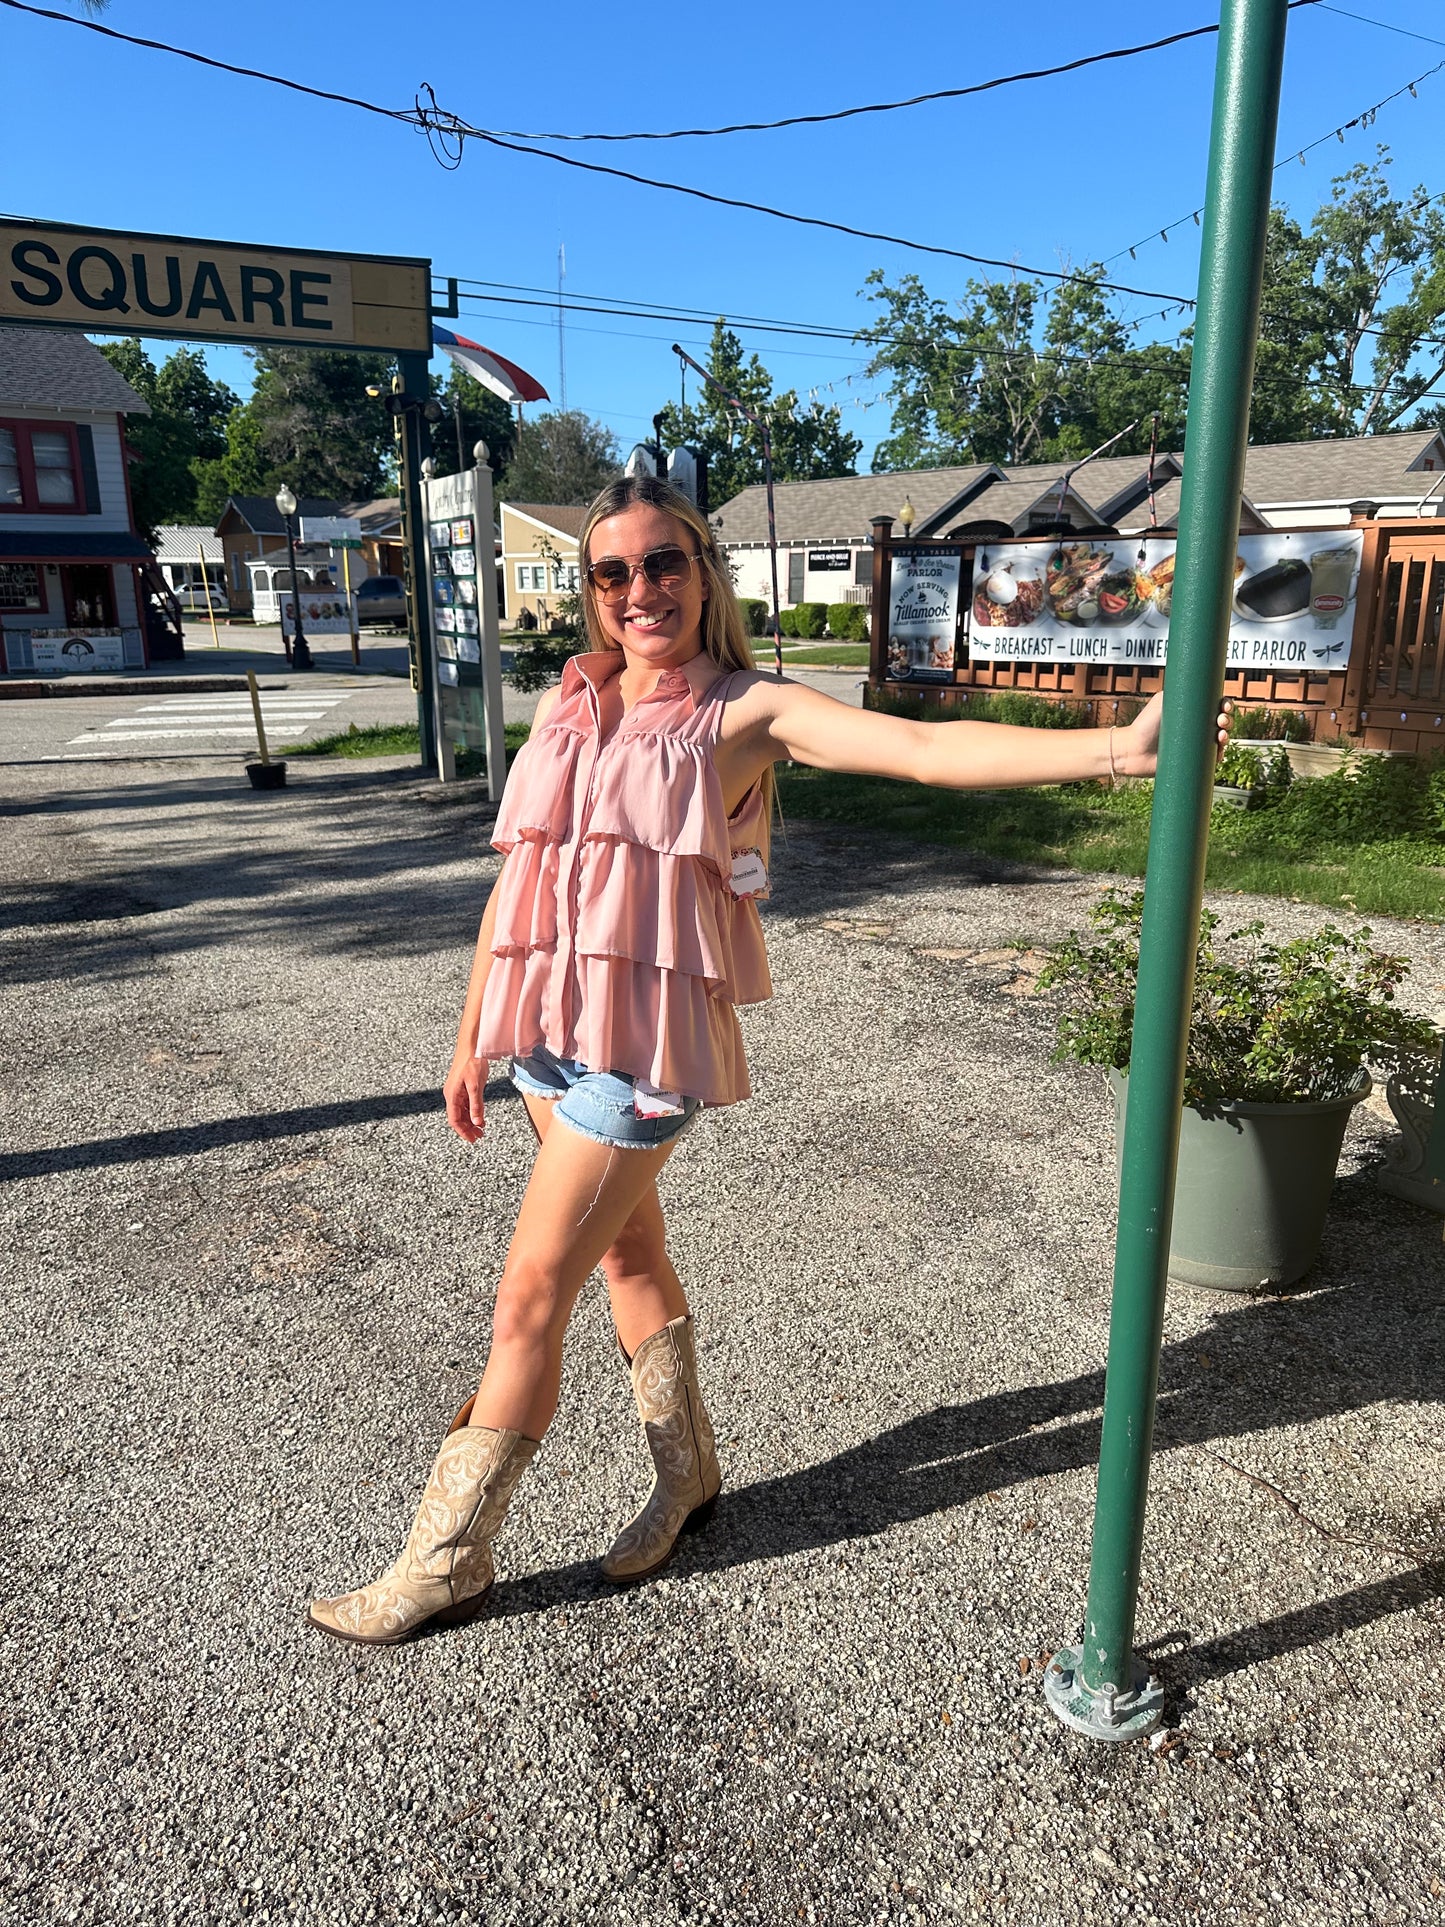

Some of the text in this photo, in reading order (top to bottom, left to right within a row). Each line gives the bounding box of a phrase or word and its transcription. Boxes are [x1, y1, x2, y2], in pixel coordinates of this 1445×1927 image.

[10, 239, 333, 330] SQUARE
[907, 568, 943, 577] PARLOR
[898, 584, 915, 604] NOW
[895, 601, 950, 621] Tillamook
[994, 637, 1054, 655] BREAKFAST
[1070, 638, 1108, 657] LUNCH
[1125, 638, 1168, 658] DINNER
[1253, 640, 1307, 661] PARLOR
